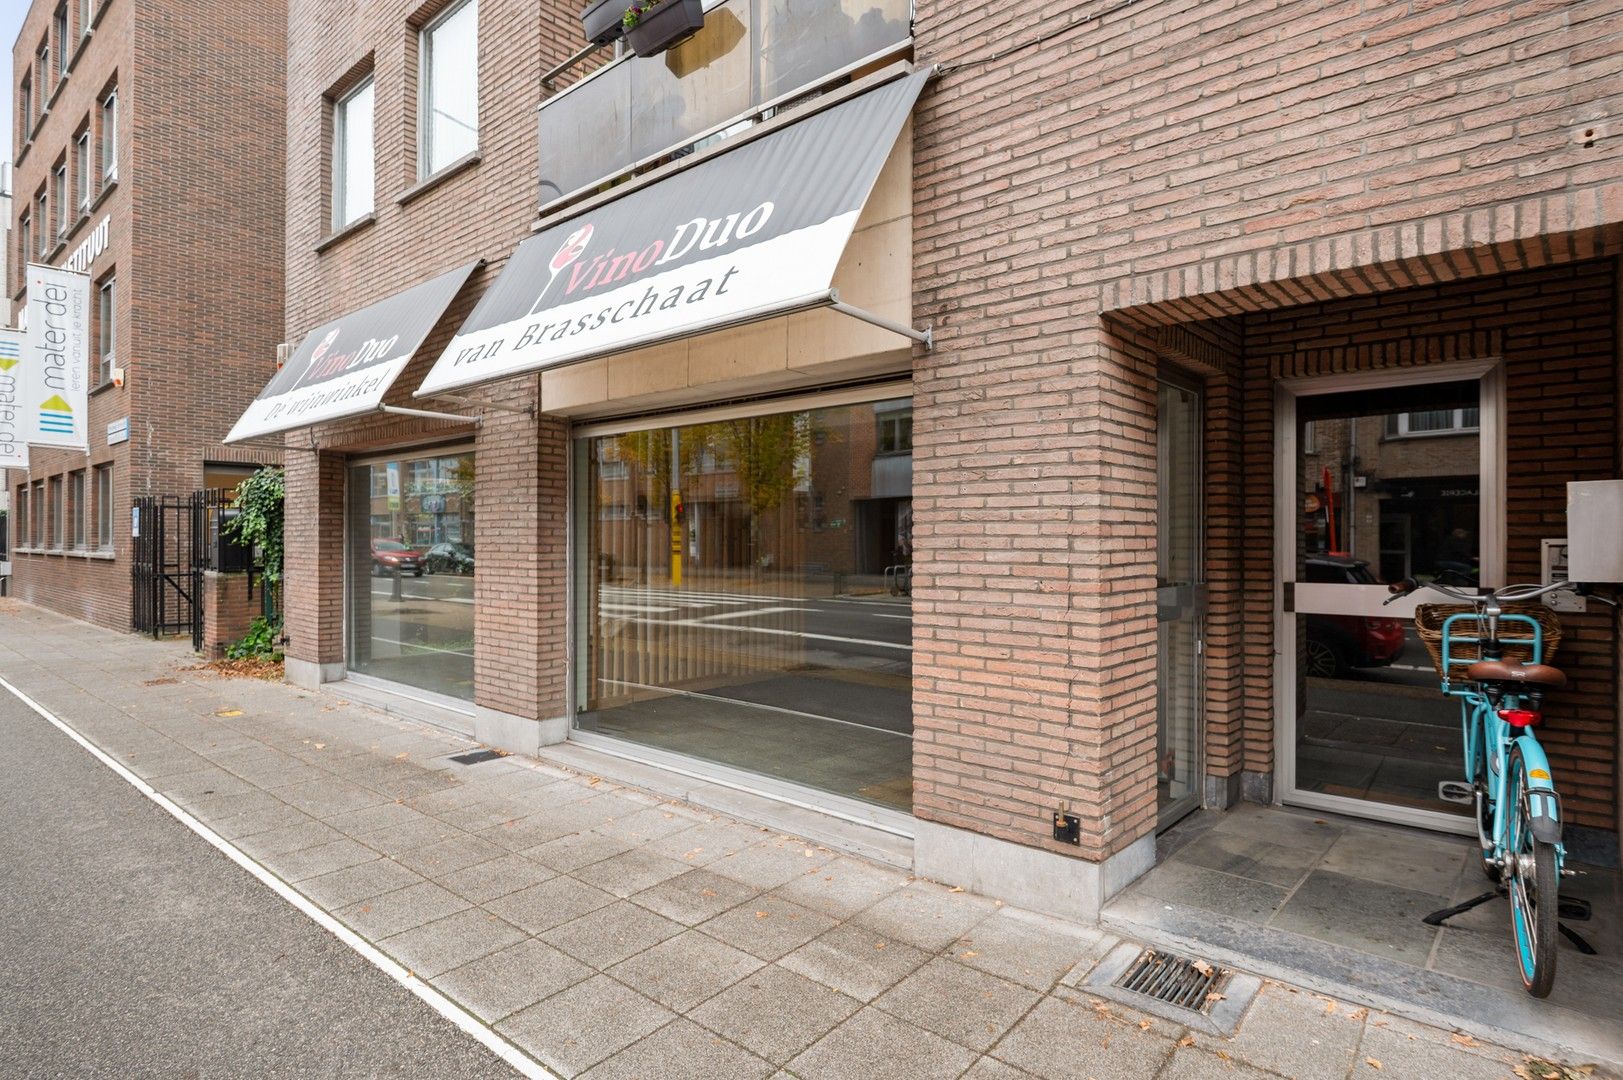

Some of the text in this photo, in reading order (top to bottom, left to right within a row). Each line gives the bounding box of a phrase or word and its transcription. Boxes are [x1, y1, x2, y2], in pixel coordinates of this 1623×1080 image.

[61, 214, 111, 272] STITUUT
[564, 202, 776, 295] VinoDuo
[72, 289, 82, 319] kracht
[453, 265, 740, 368] van Brasschaat
[72, 332, 81, 363] vanuit
[308, 334, 399, 380] VinoDuo
[71, 367, 81, 392] leren
[264, 367, 392, 421] De wijnwinkel
